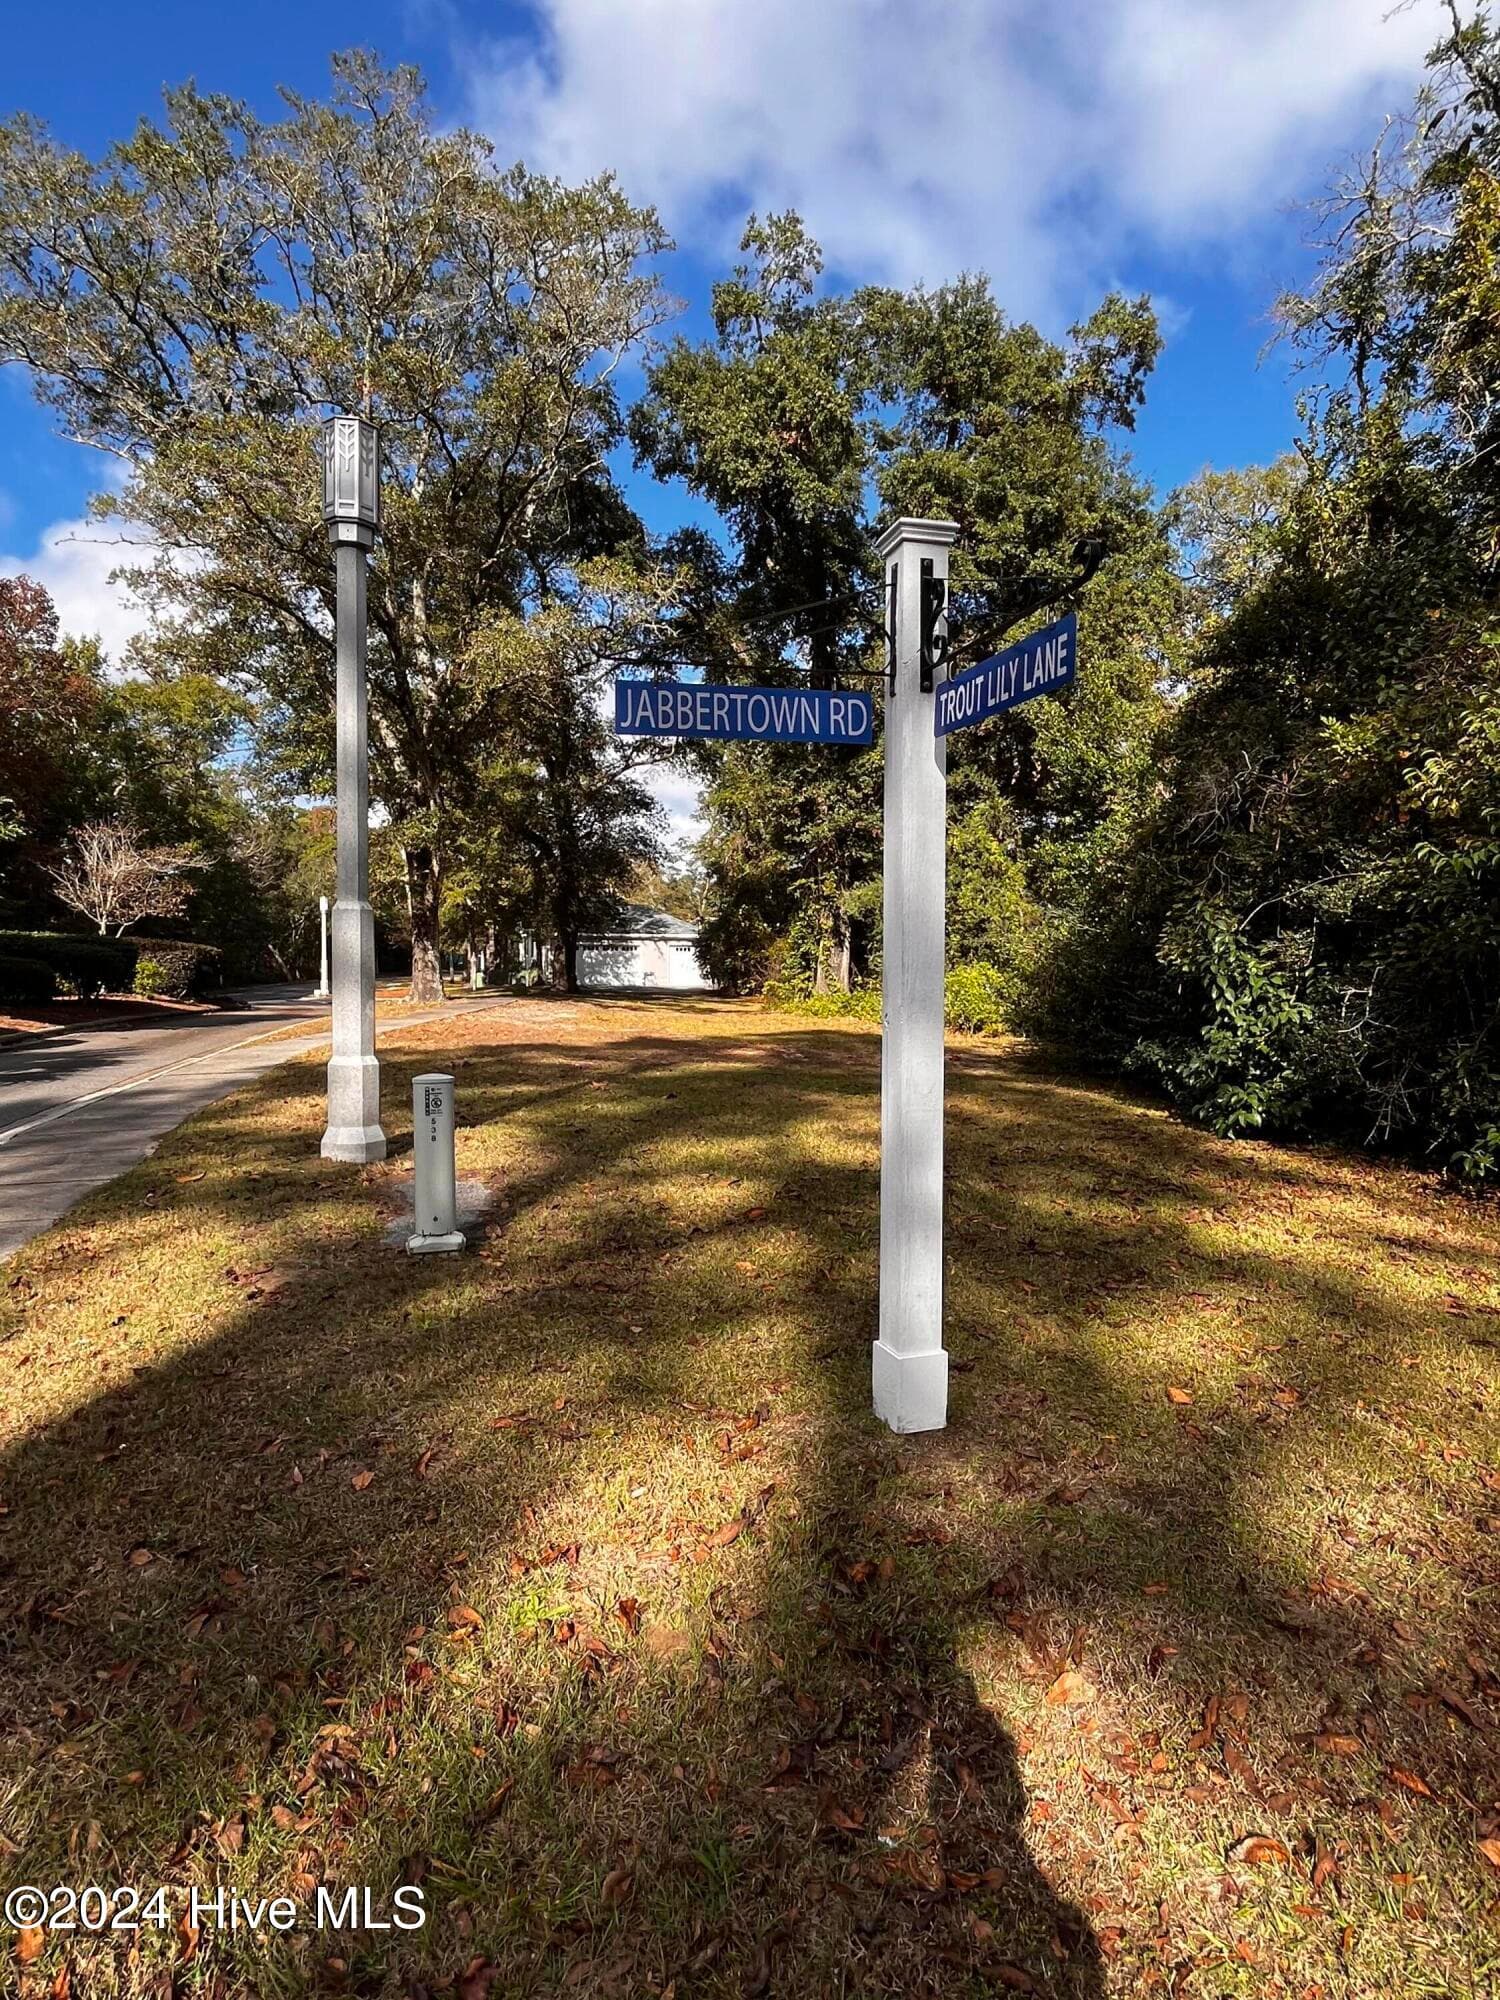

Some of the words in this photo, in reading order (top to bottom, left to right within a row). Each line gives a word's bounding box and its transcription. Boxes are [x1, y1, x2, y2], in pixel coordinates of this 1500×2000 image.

[620, 688, 819, 733] JABBERTOWN
[830, 699, 868, 737] RD
[940, 675, 984, 727] TROUT
[987, 657, 1019, 707] LILY
[1023, 632, 1068, 692] LANE
